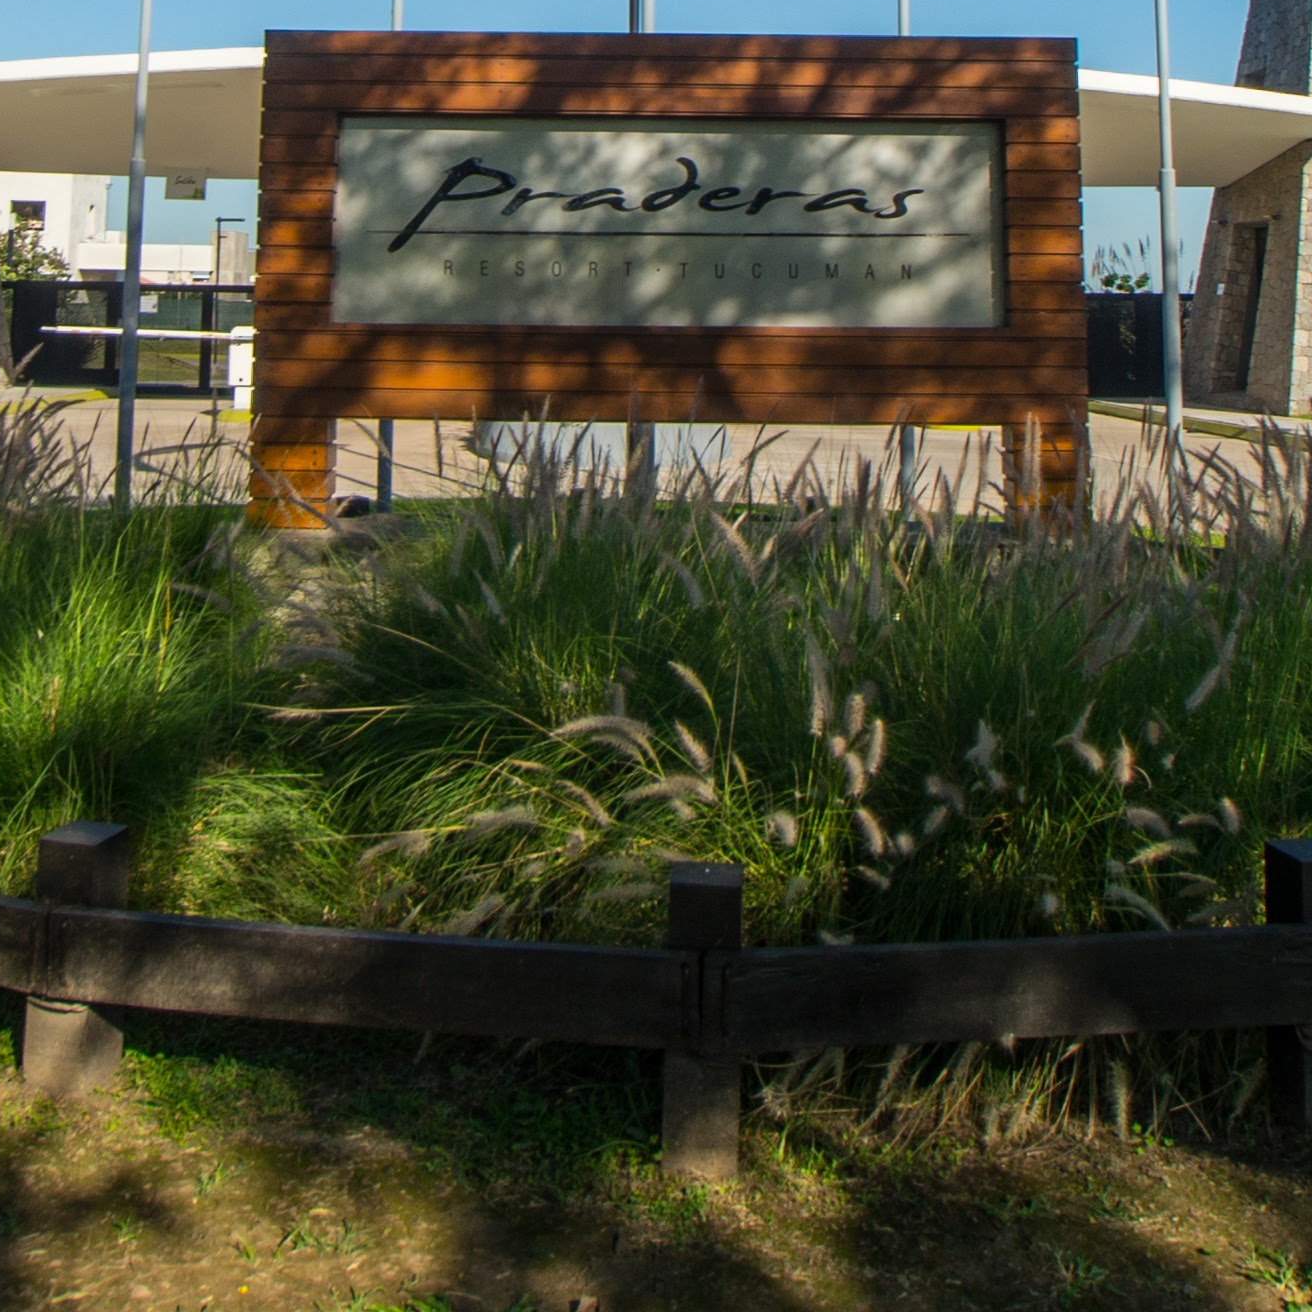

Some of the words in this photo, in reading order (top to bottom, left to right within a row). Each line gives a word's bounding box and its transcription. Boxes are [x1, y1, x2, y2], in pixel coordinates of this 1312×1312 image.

[387, 156, 924, 253] Praderas
[443, 259, 633, 278] RESORT
[679, 261, 912, 281] TUCUMAN
